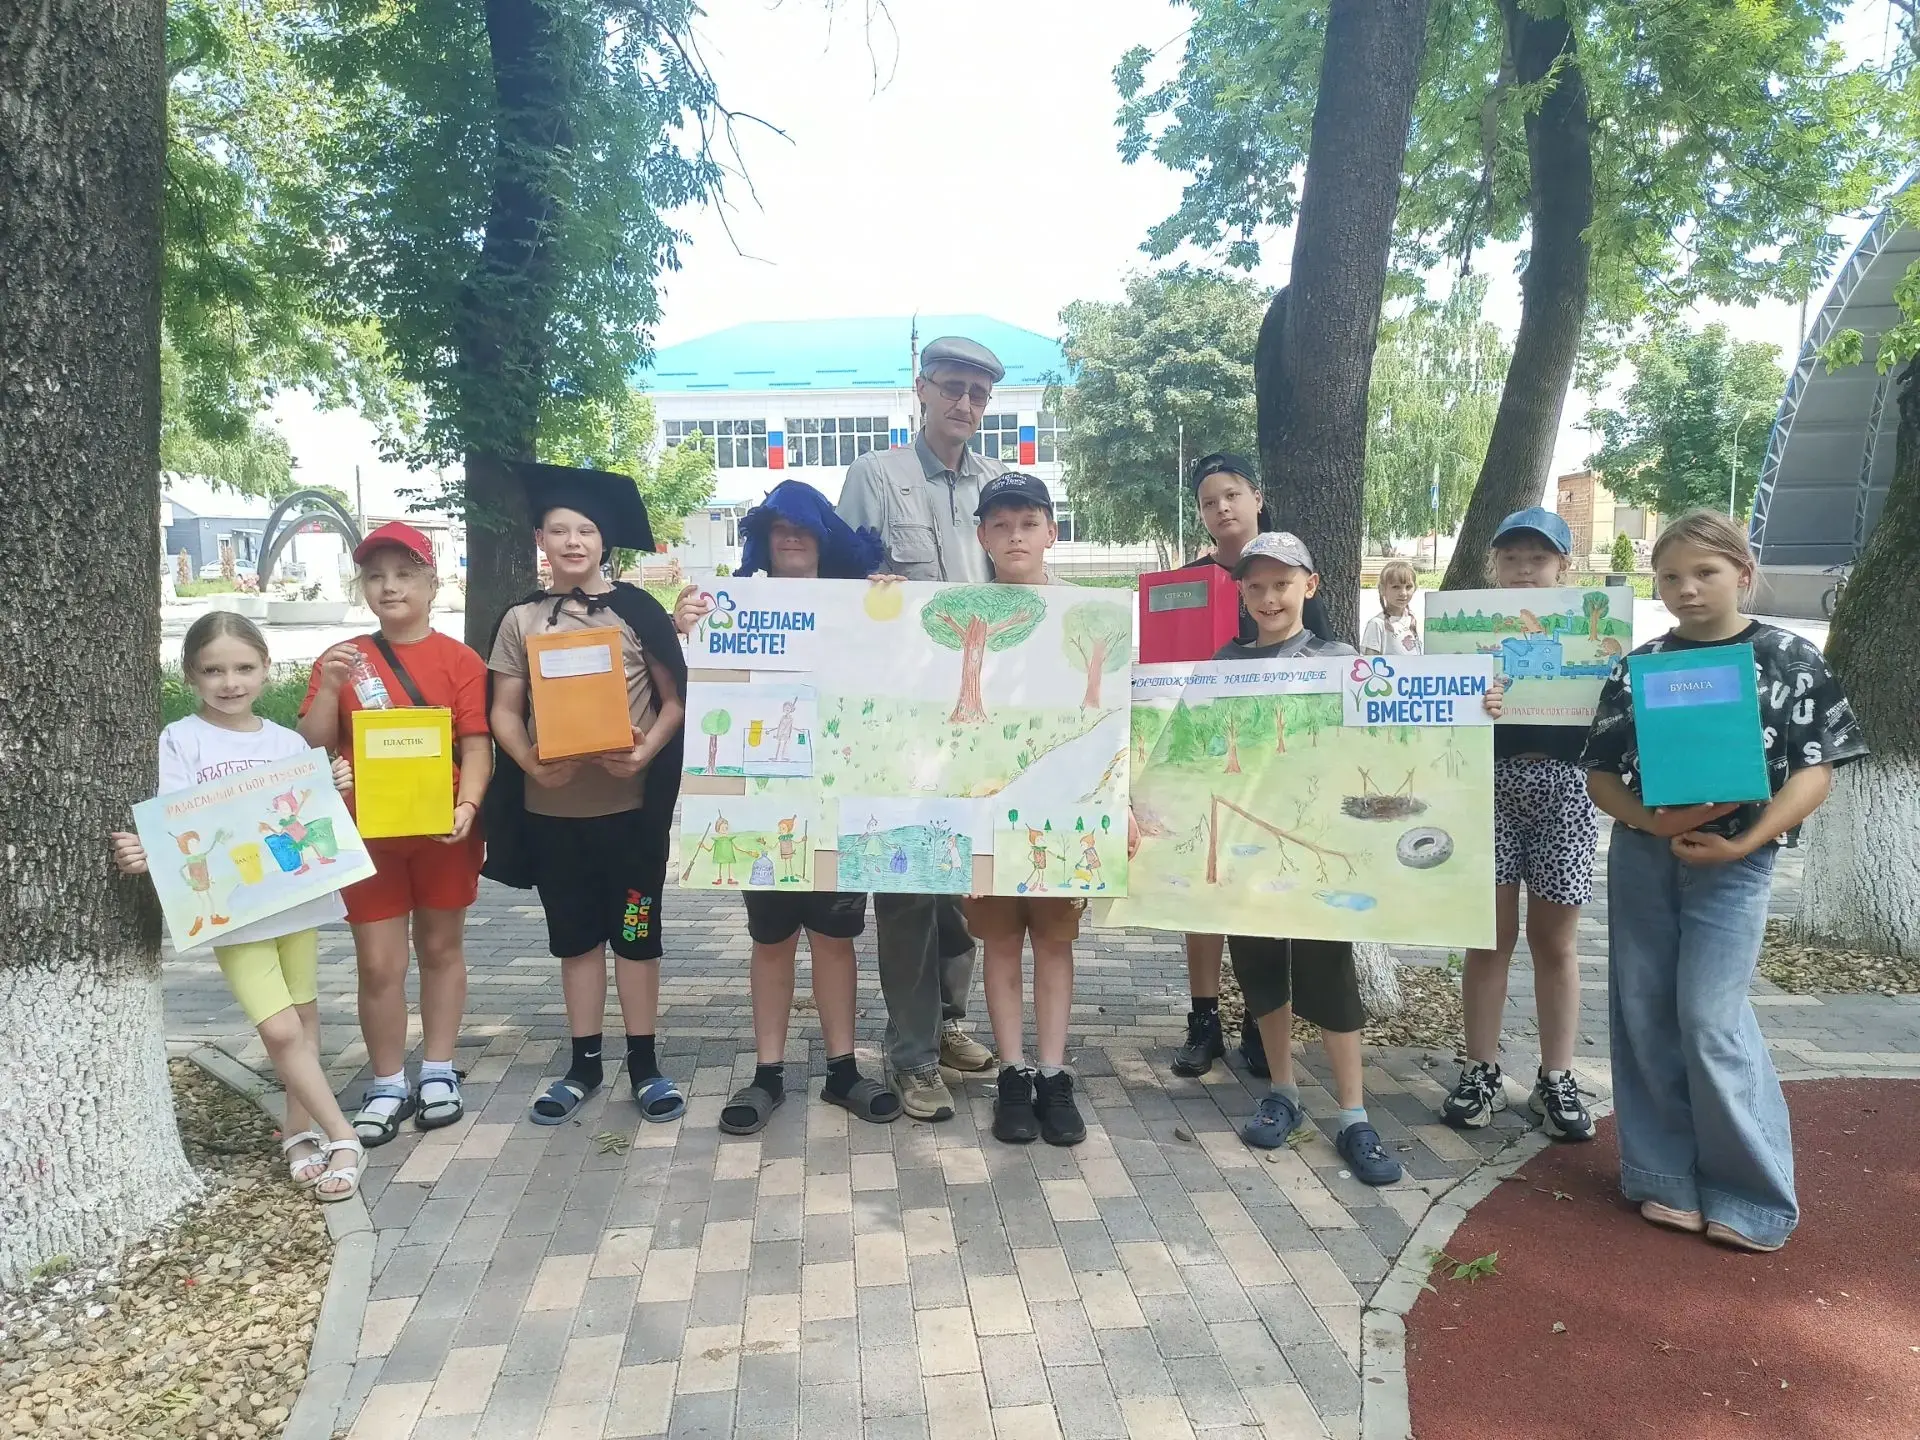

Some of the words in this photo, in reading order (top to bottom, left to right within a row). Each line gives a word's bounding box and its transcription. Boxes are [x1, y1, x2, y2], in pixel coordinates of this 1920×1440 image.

[737, 610, 815, 633] СДЕЛАЕМ
[709, 632, 786, 655] ВМЕСТЕ!
[1132, 674, 1218, 688] НИЧТОЖАЙТЕ
[1224, 673, 1261, 685] НАШЕ
[1262, 670, 1328, 682] БУДУЩЕЕ
[1397, 675, 1487, 700] СДЕЛАЕМ
[1670, 681, 1713, 692] БУМАГА
[1366, 700, 1454, 723] ВМЕСТЕ!
[383, 738, 424, 747] ПЛАСТИК
[238, 776, 266, 793] СБОР
[623, 888, 642, 942] MARIO
[637, 896, 652, 938] SUPER
